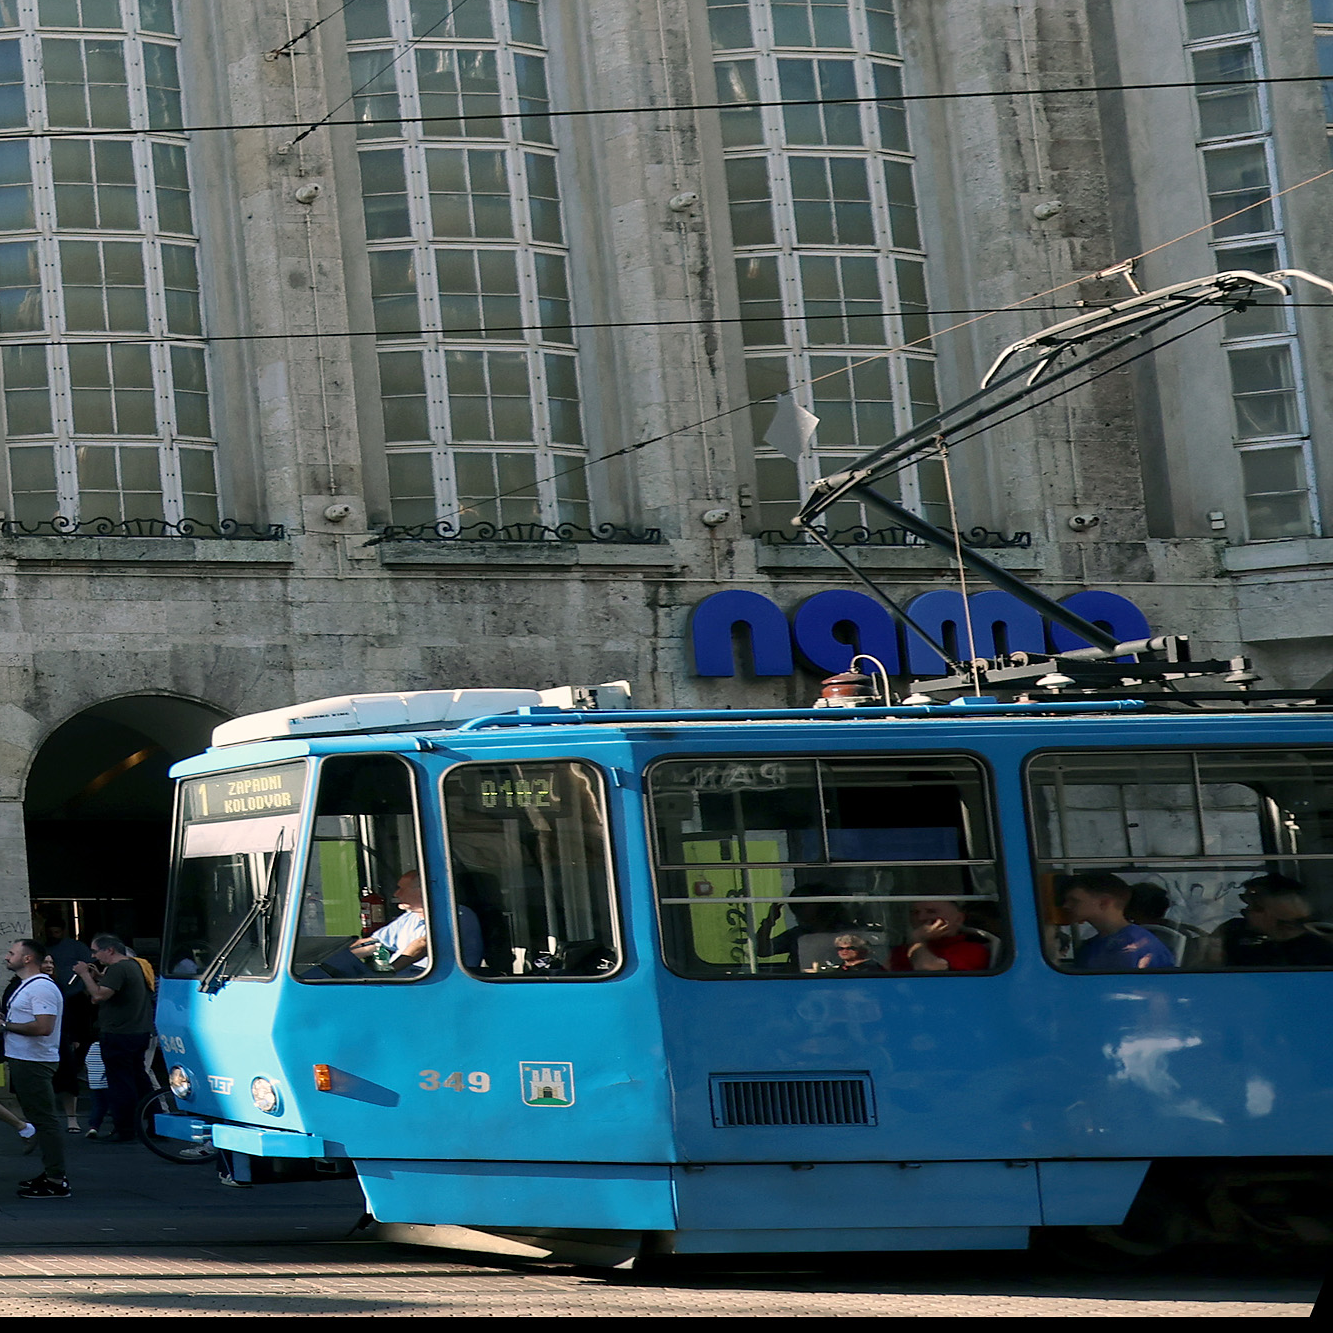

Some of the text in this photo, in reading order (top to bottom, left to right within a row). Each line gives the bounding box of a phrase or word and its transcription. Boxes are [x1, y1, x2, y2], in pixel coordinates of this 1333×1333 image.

[691, 589, 1151, 677] nama
[227, 775, 282, 796] ZAPADNI
[198, 783, 209, 817] 1
[223, 792, 292, 814] KOLODVOR
[160, 1034, 186, 1054] 349
[207, 1075, 235, 1096] ZET
[419, 1069, 491, 1093] 349
